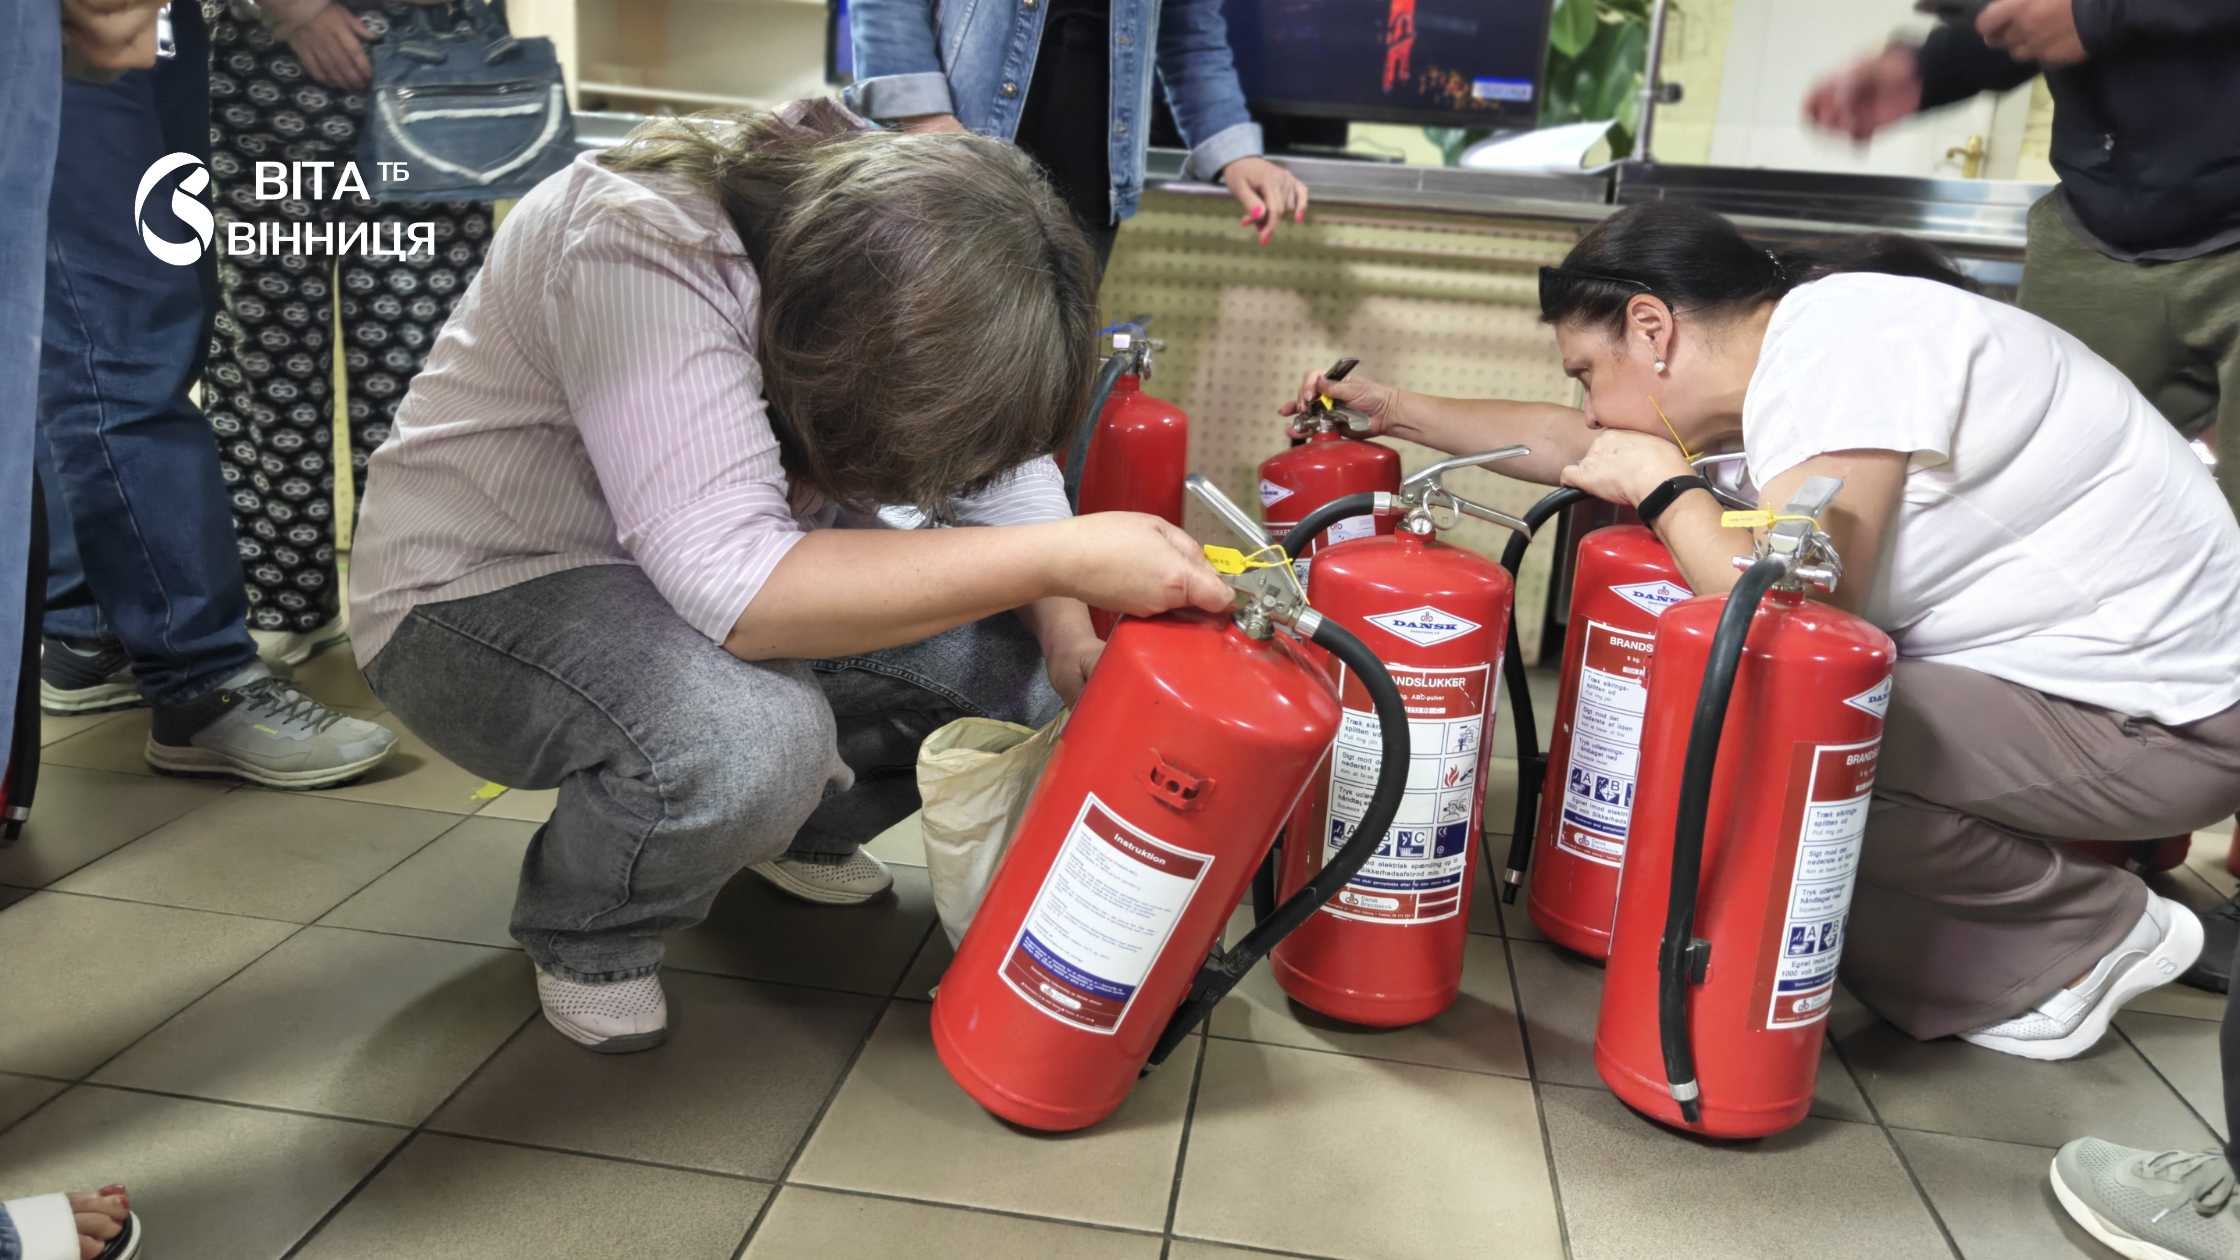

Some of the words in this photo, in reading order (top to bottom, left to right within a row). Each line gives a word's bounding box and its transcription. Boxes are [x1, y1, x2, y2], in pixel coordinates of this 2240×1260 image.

[1633, 590, 1680, 602] DANS
[1392, 620, 1458, 630] DANSK
[1609, 636, 1654, 653] BRANDS
[1391, 675, 1466, 688] ANDSLUKKER
[1582, 773, 1592, 784] A
[1610, 780, 1620, 792] B
[1414, 832, 1425, 843] C
[1114, 832, 1166, 866] Instruktion
[1806, 926, 1816, 938] A
